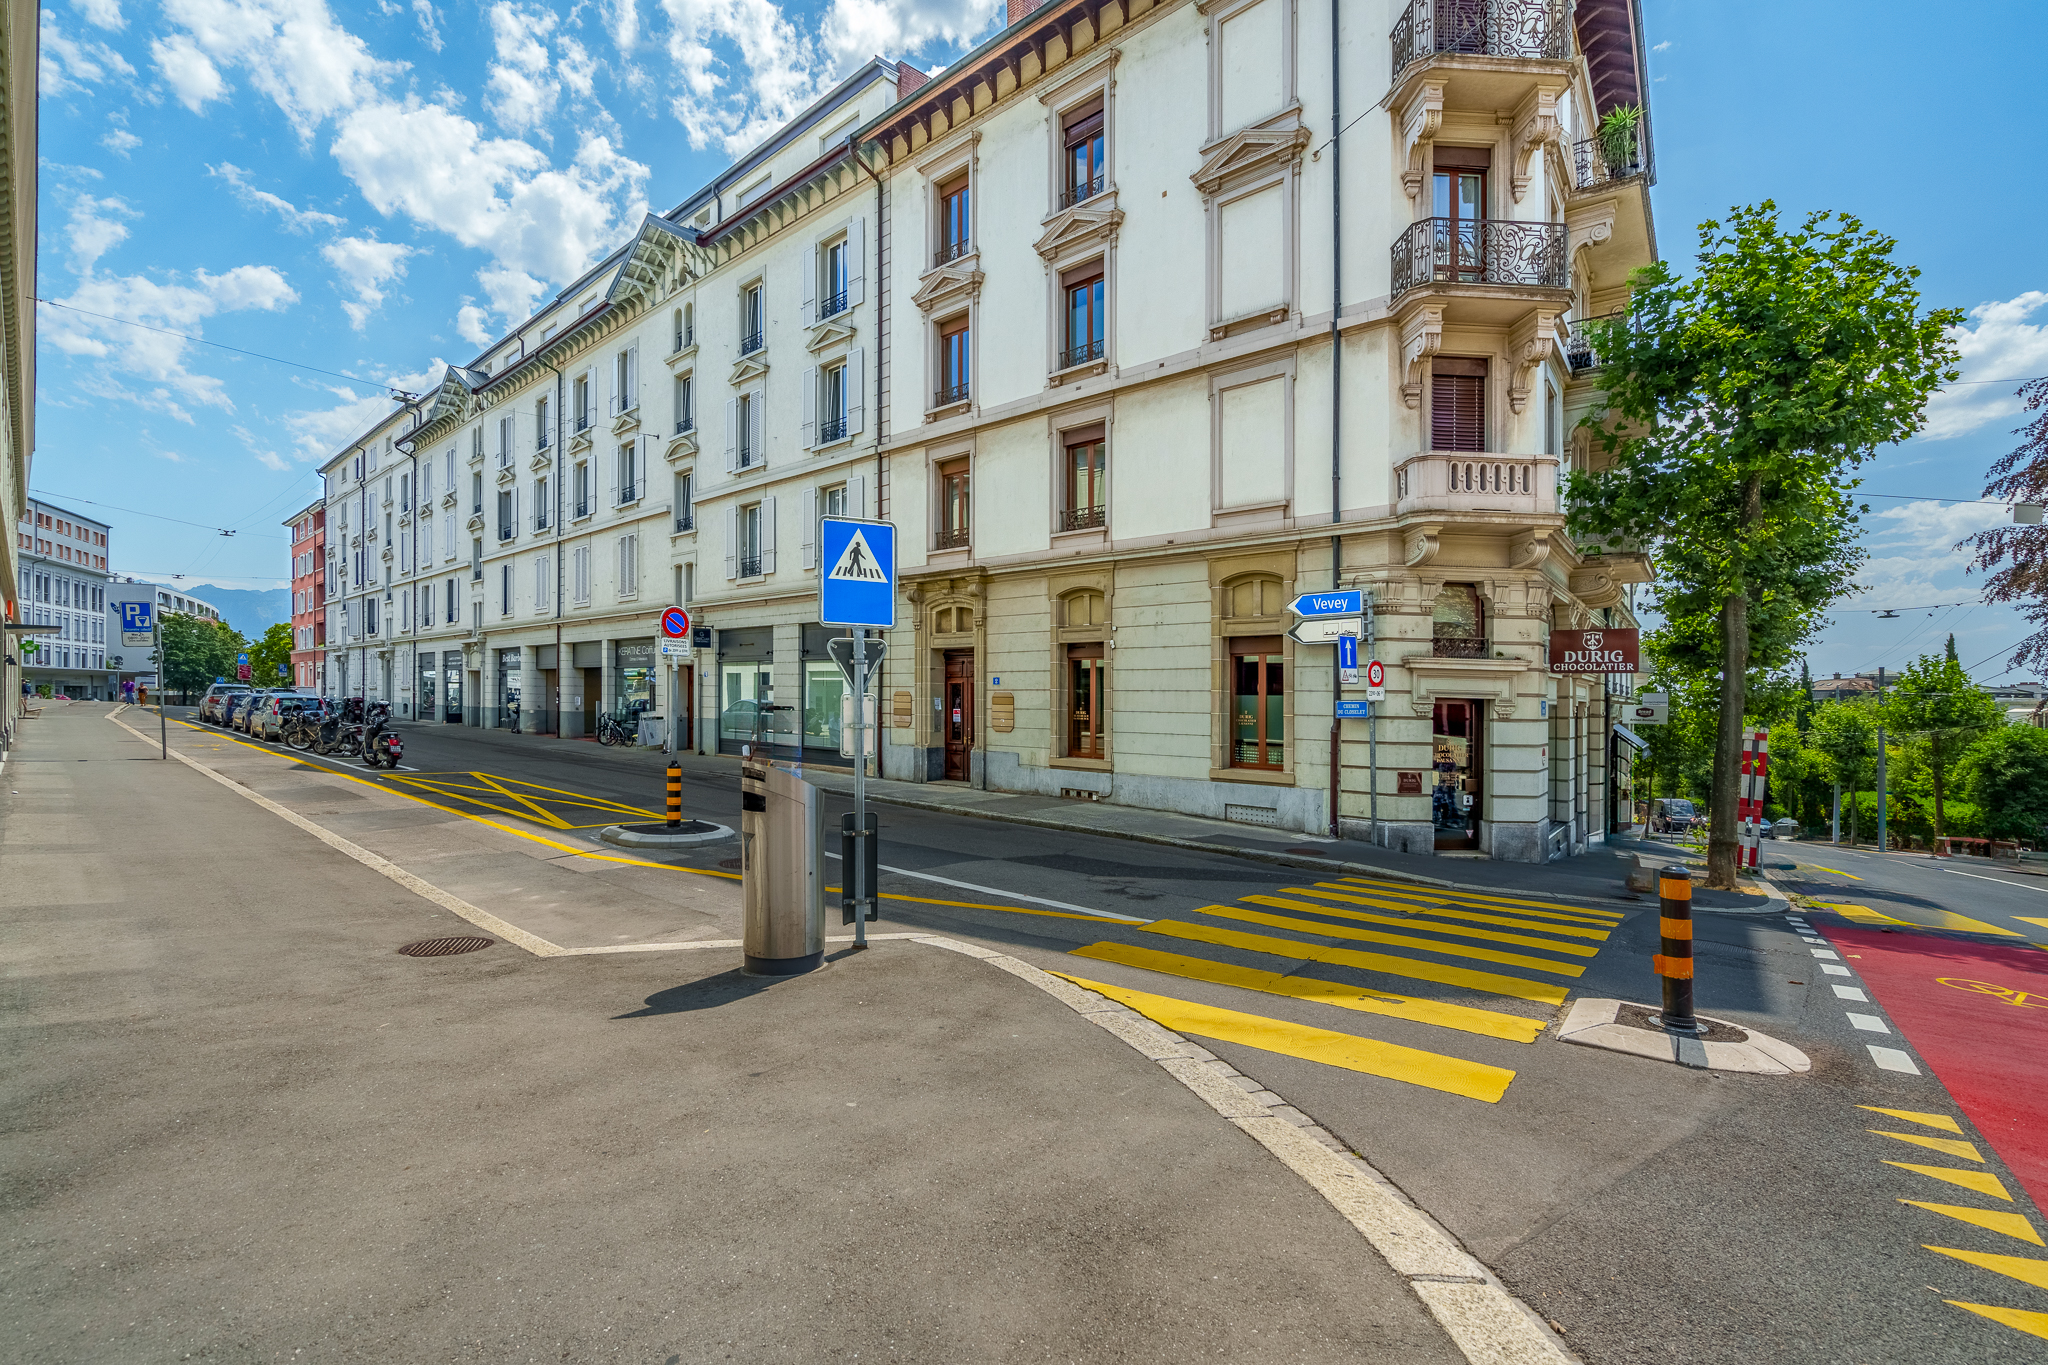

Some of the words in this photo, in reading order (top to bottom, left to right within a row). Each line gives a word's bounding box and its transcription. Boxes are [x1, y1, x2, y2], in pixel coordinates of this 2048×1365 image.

[1313, 598, 1348, 611] Vevey
[126, 604, 140, 620] P
[1564, 650, 1624, 663] DURIG
[1553, 663, 1634, 671] CHOCOLATIER
[1373, 669, 1380, 679] 30
